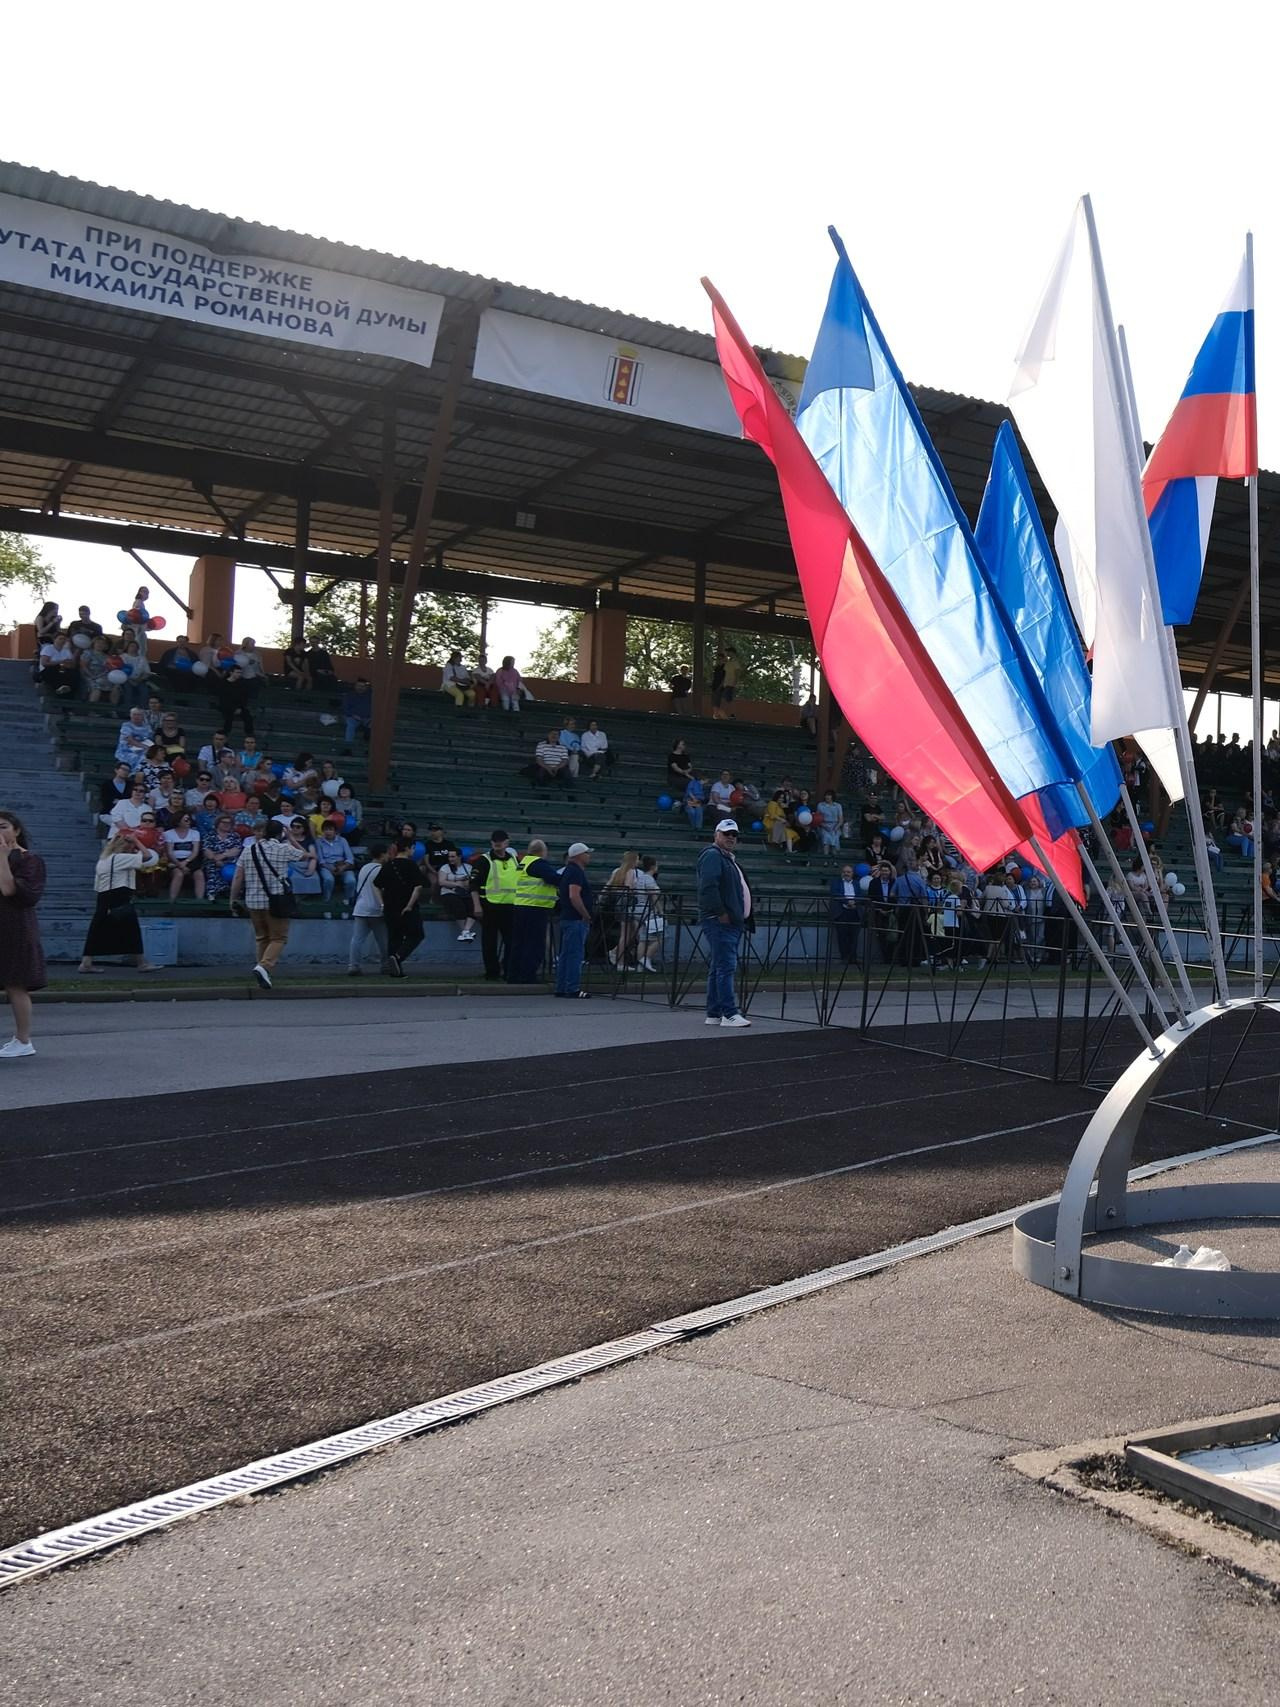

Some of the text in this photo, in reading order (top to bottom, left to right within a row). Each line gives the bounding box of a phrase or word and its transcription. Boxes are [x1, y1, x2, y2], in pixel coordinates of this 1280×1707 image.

[85, 225, 313, 292] ПРИ ПОДДЕРЖКЕ
[96, 251, 350, 320] ГОСУДАРСТВЕННОЙ
[355, 308, 427, 336] ДУМЫ
[50, 263, 335, 338] МИХАИЛА РОМАНОВА
